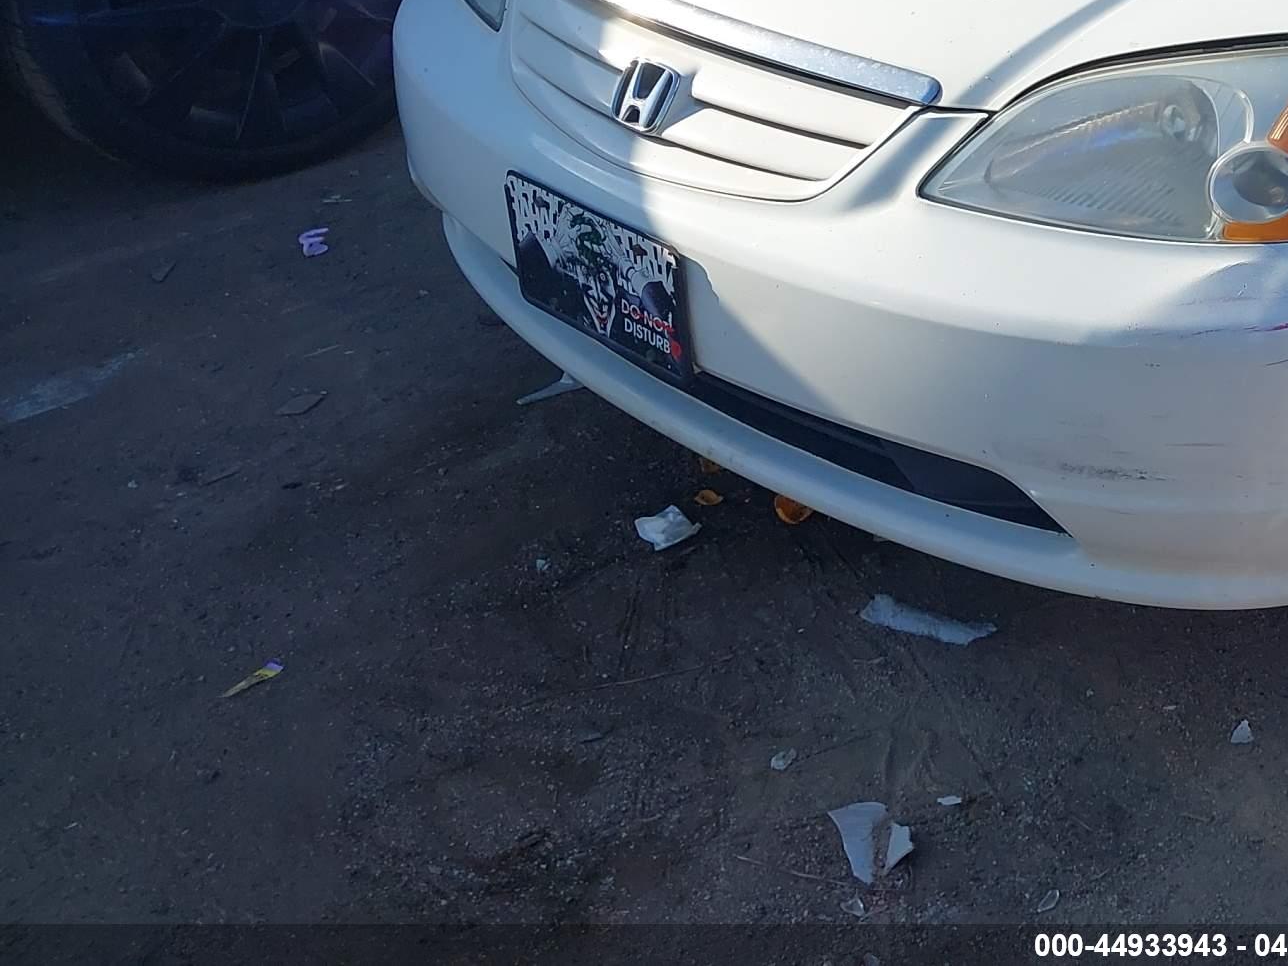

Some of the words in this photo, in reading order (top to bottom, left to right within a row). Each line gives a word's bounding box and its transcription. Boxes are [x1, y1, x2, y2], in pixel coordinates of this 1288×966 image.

[621, 298, 640, 319] DO
[643, 311, 672, 338] NOT
[624, 318, 670, 353] DISTURB
